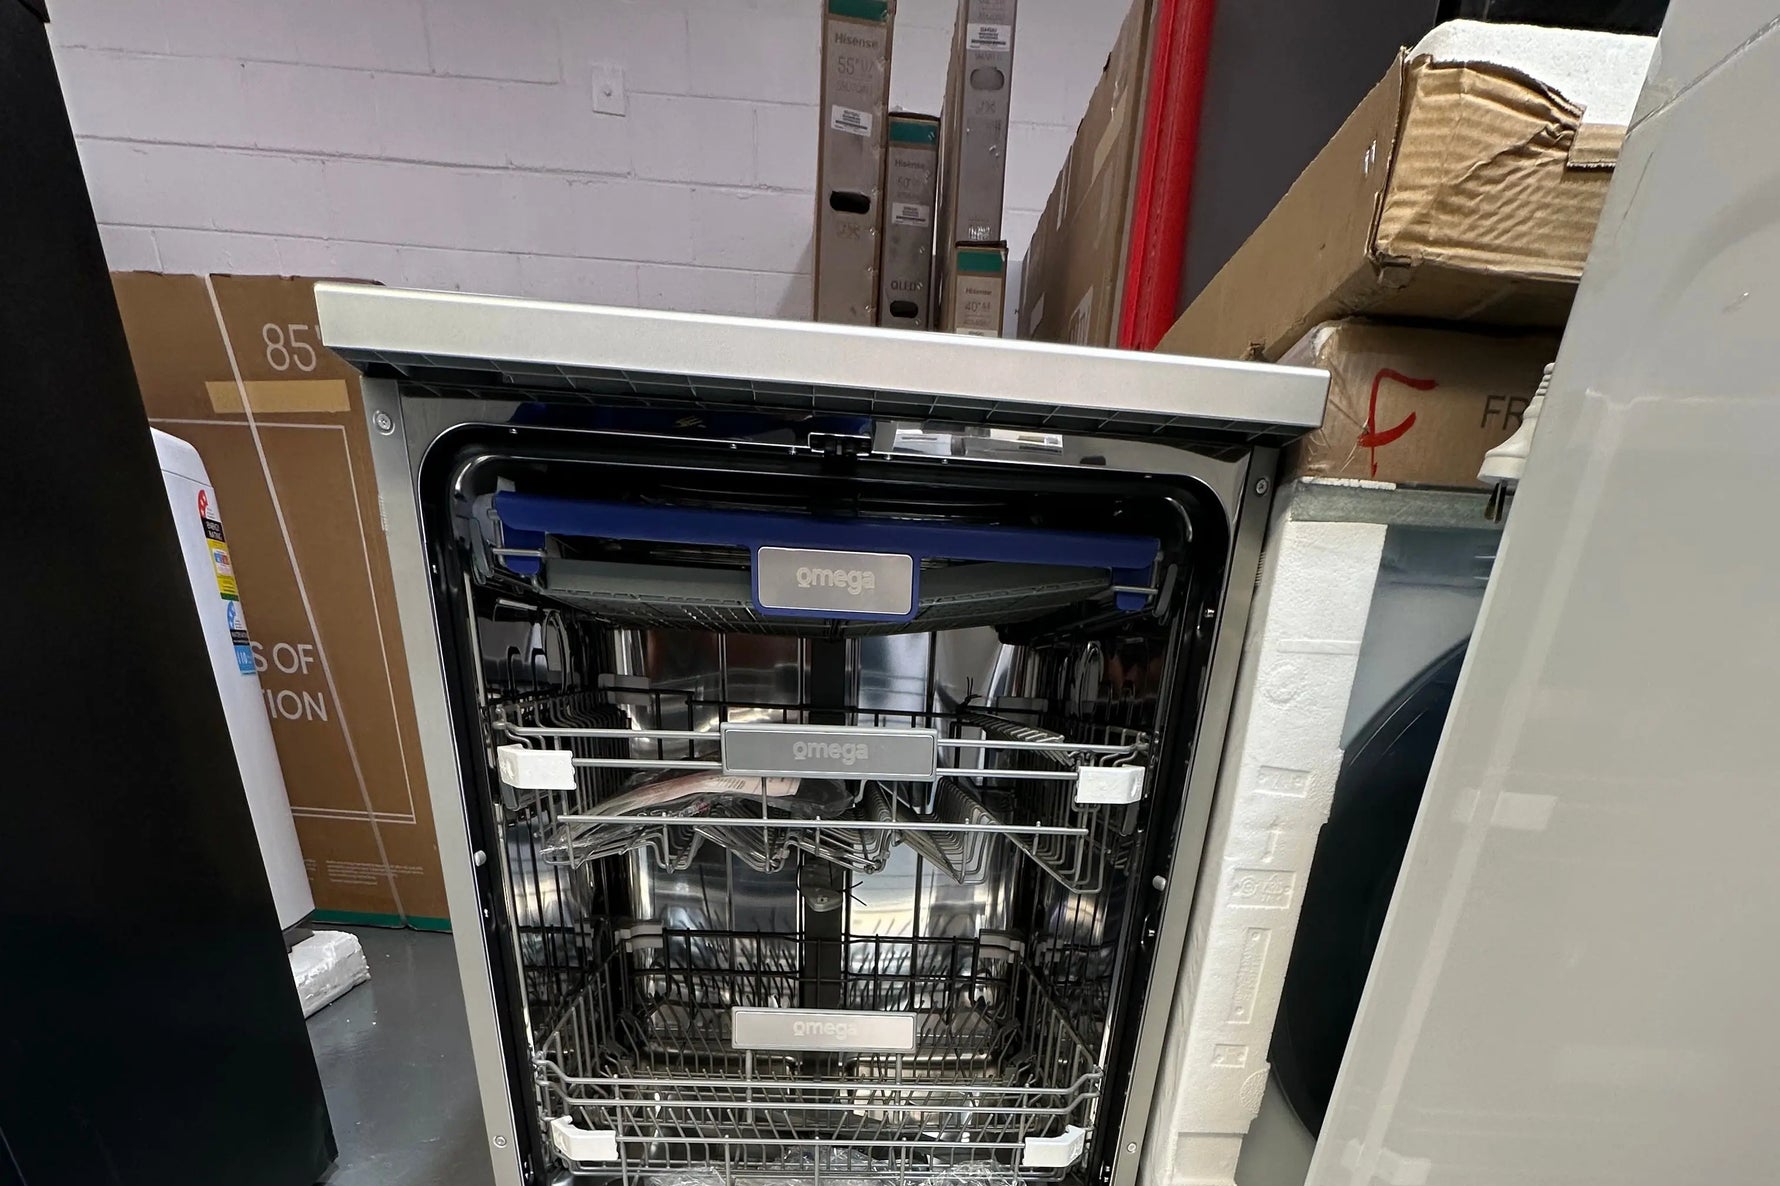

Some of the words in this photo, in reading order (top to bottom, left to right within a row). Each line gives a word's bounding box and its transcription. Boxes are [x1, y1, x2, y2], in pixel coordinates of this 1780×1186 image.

[834, 32, 878, 49] Hisense
[272, 642, 314, 675] OF
[261, 688, 328, 722] ION
